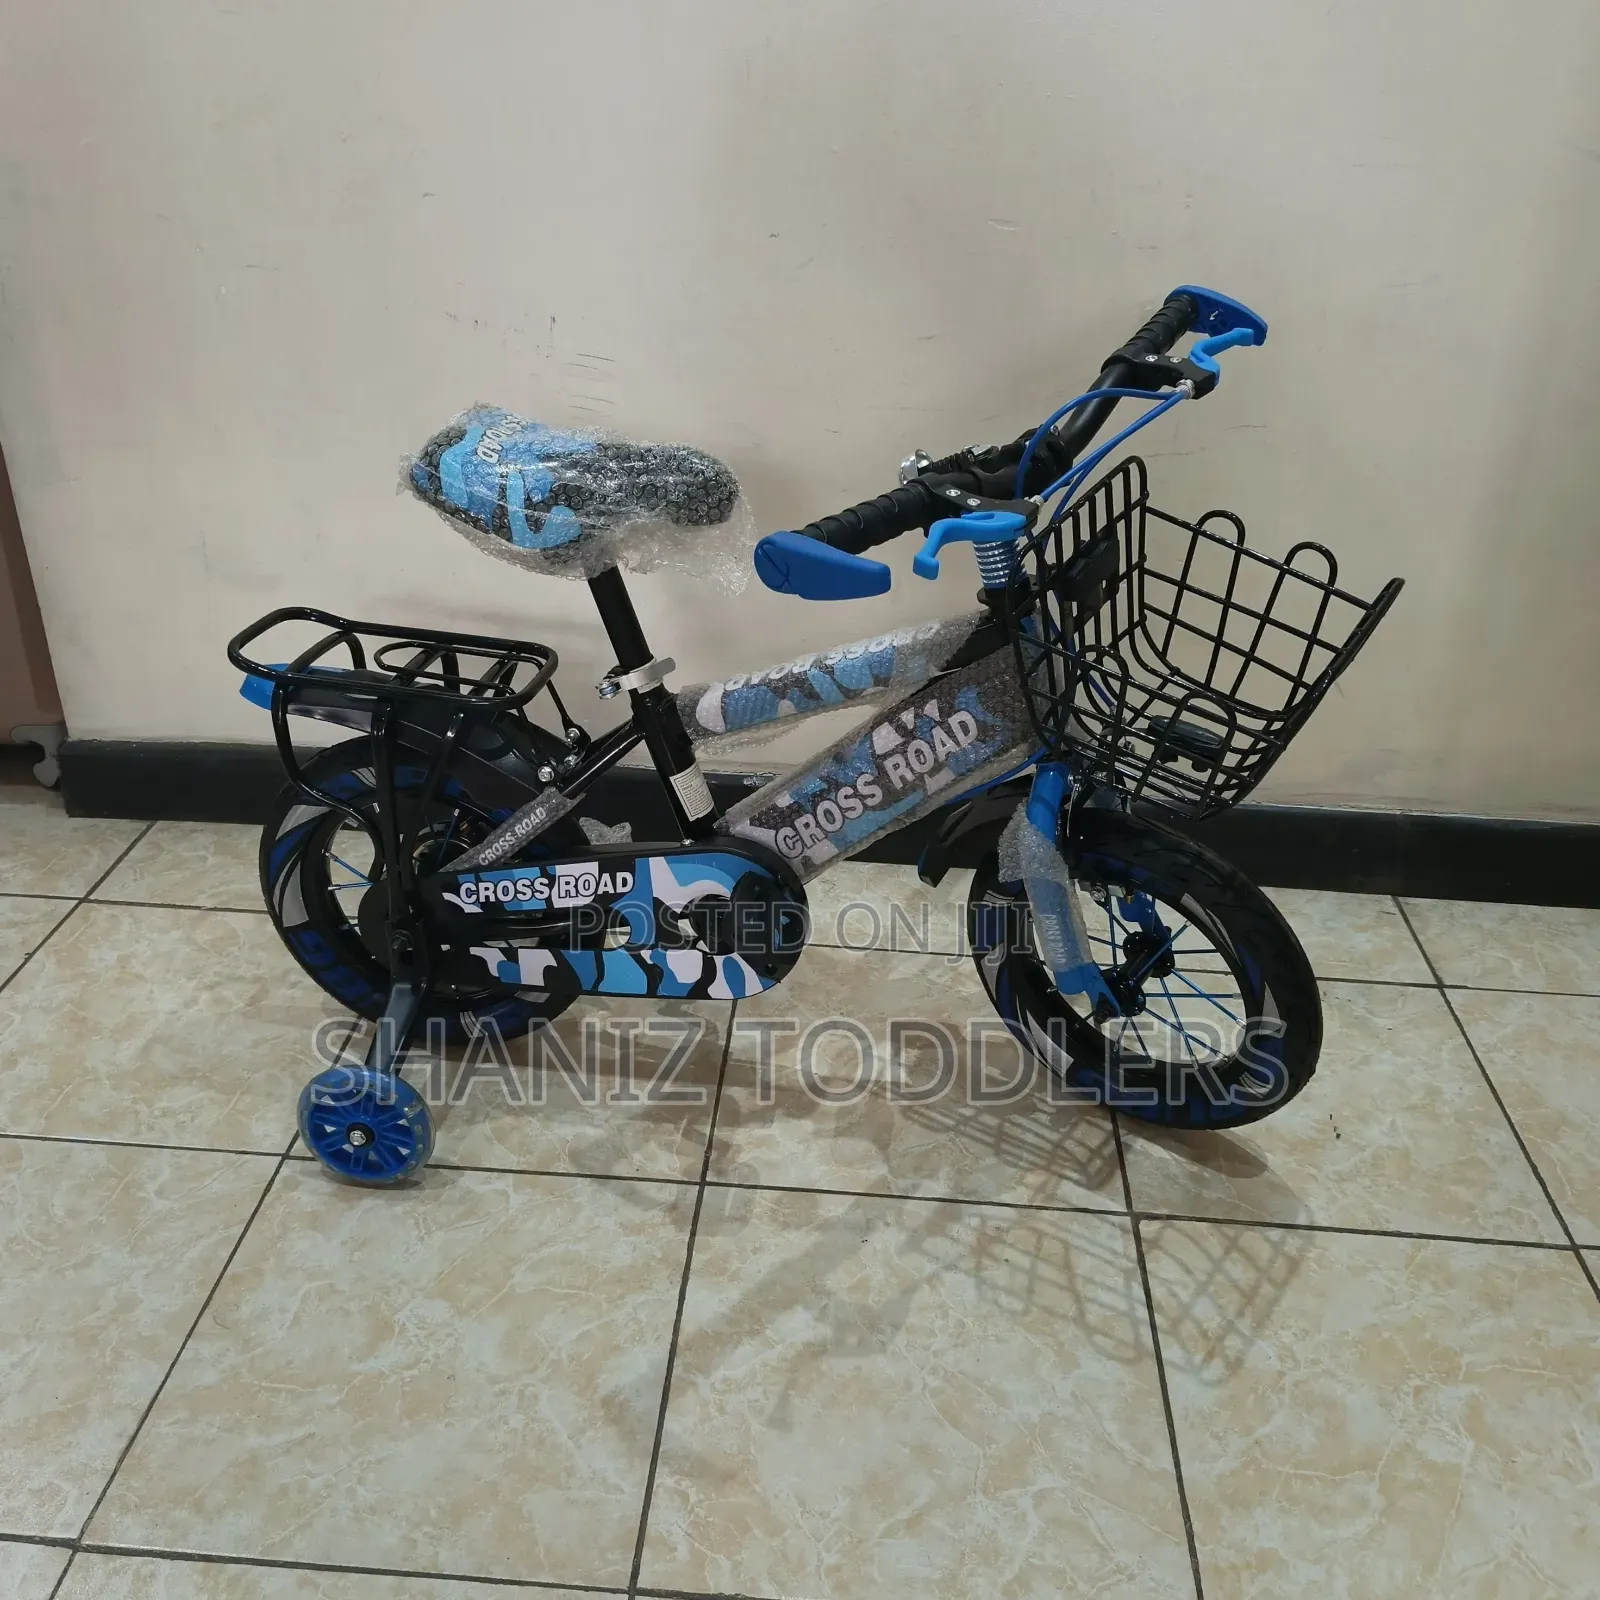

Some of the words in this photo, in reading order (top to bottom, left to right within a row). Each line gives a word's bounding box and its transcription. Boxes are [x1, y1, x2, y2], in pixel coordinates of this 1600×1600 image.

[775, 774, 883, 859] CROSS
[884, 711, 978, 789] ROAD
[459, 878, 550, 904] CROSS
[558, 871, 634, 899] ROAD
